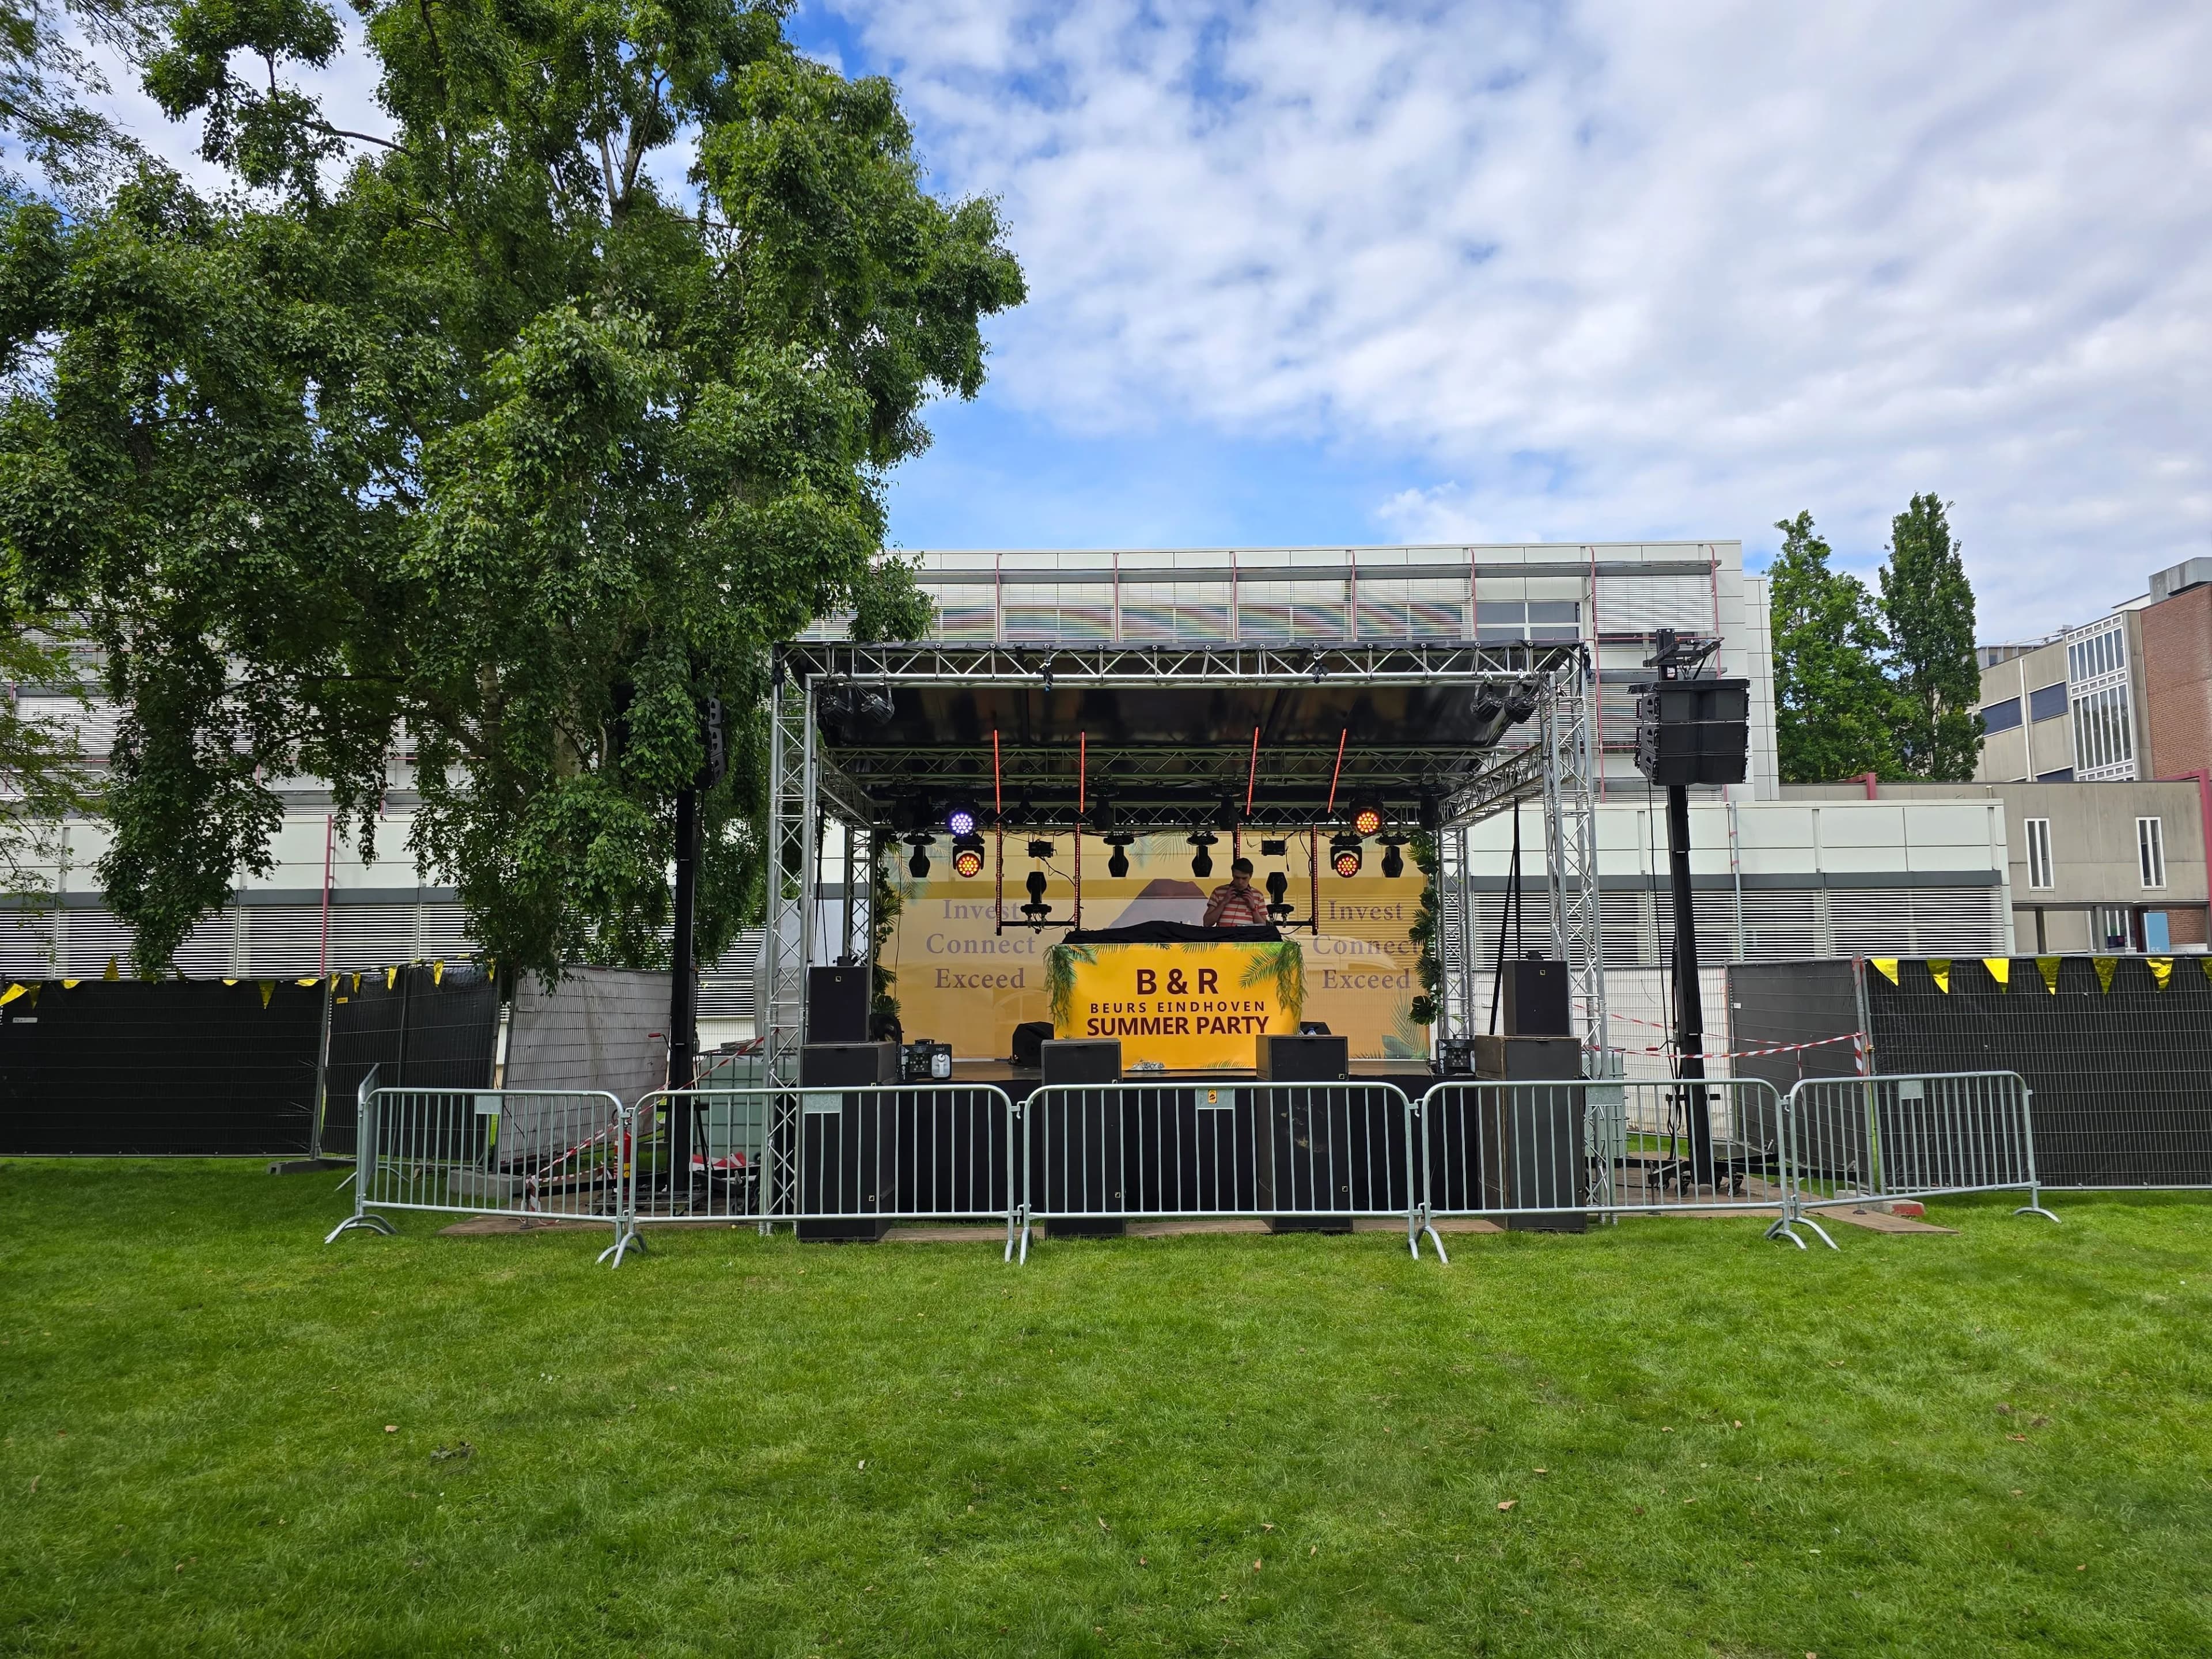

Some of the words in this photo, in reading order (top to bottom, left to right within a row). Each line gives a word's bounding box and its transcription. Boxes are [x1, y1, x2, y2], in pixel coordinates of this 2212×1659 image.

[942, 899, 1020, 920] Invest
[1328, 899, 1404, 921] Invest
[926, 933, 1036, 954] Connect
[934, 968, 1026, 988] Exceed
[1137, 969, 1157, 995] B
[1167, 968, 1189, 995] &
[1198, 968, 1219, 994] R
[1322, 968, 1411, 990] Exceed
[1090, 1002, 1146, 1013] BEURS
[1157, 1001, 1264, 1013] EINDHOVEN
[1087, 1017, 1190, 1036] SUMMER
[1196, 1016, 1269, 1035] PARTY
